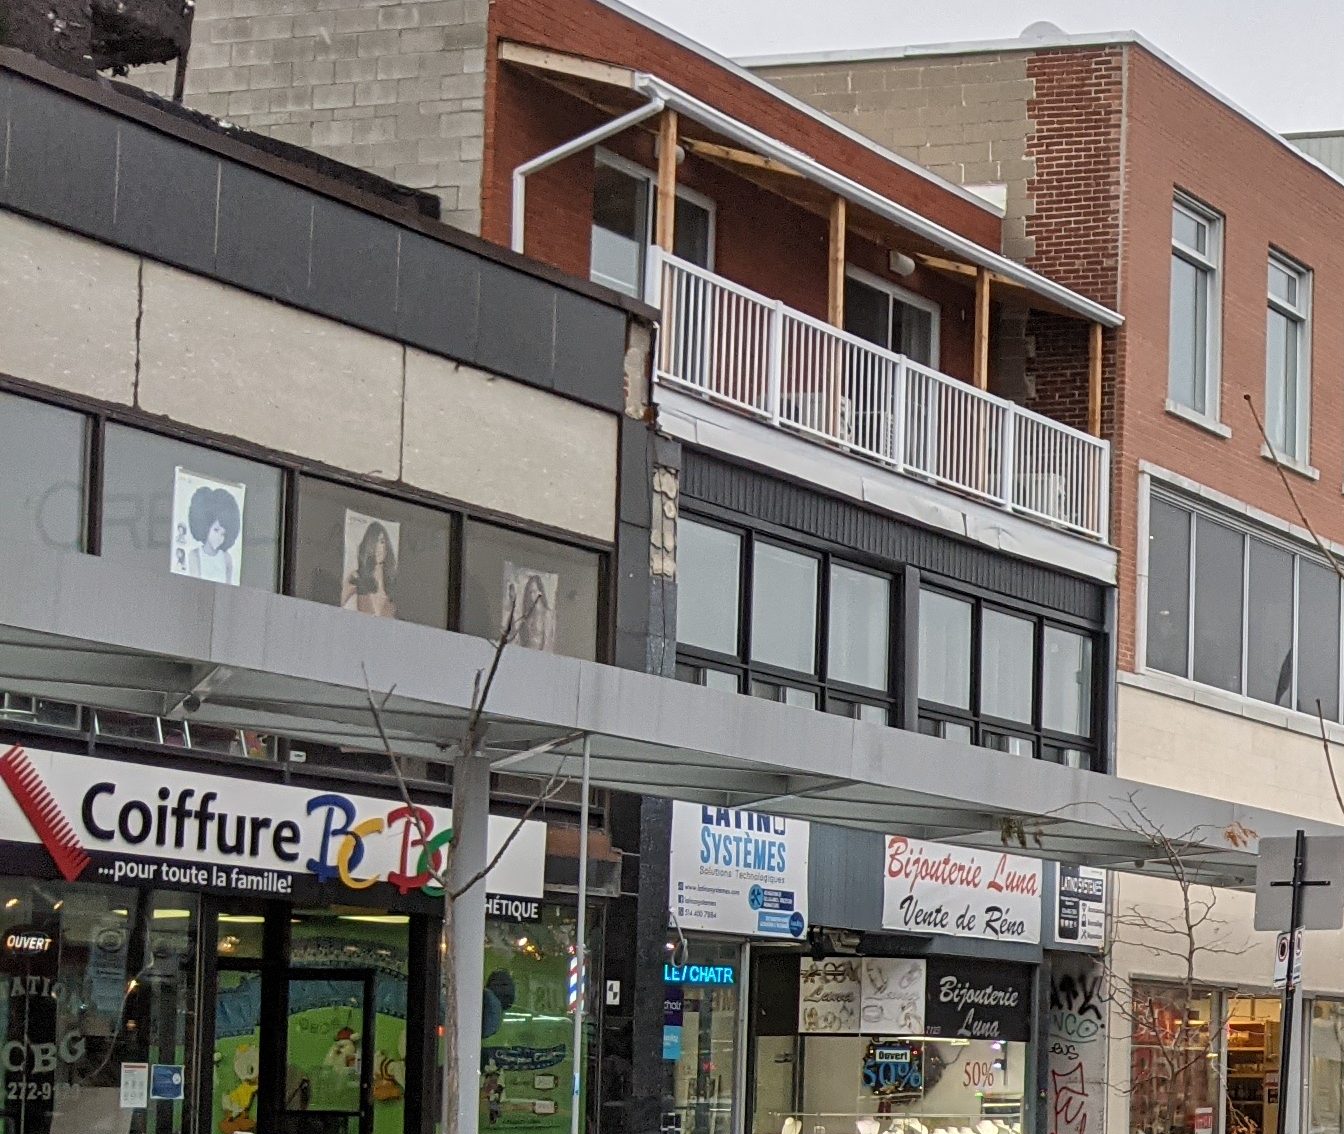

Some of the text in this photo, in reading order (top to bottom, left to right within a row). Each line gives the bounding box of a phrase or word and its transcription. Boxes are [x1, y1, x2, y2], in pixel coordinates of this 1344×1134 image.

[82, 782, 301, 862] Coiffure
[700, 825, 786, 872] SYSTÈMES
[98, 860, 292, 893] ...pour toute la famille!
[699, 865, 785, 884] Solutions Technologiques
[887, 836, 1039, 896] Bijouterie Luna
[899, 894, 1026, 937] Vente de Réno
[6, 934, 51, 951] OUVERT
[939, 975, 1019, 1011] Bijouterie
[956, 1007, 1000, 1037] Luna
[963, 1061, 995, 1087] 50%
